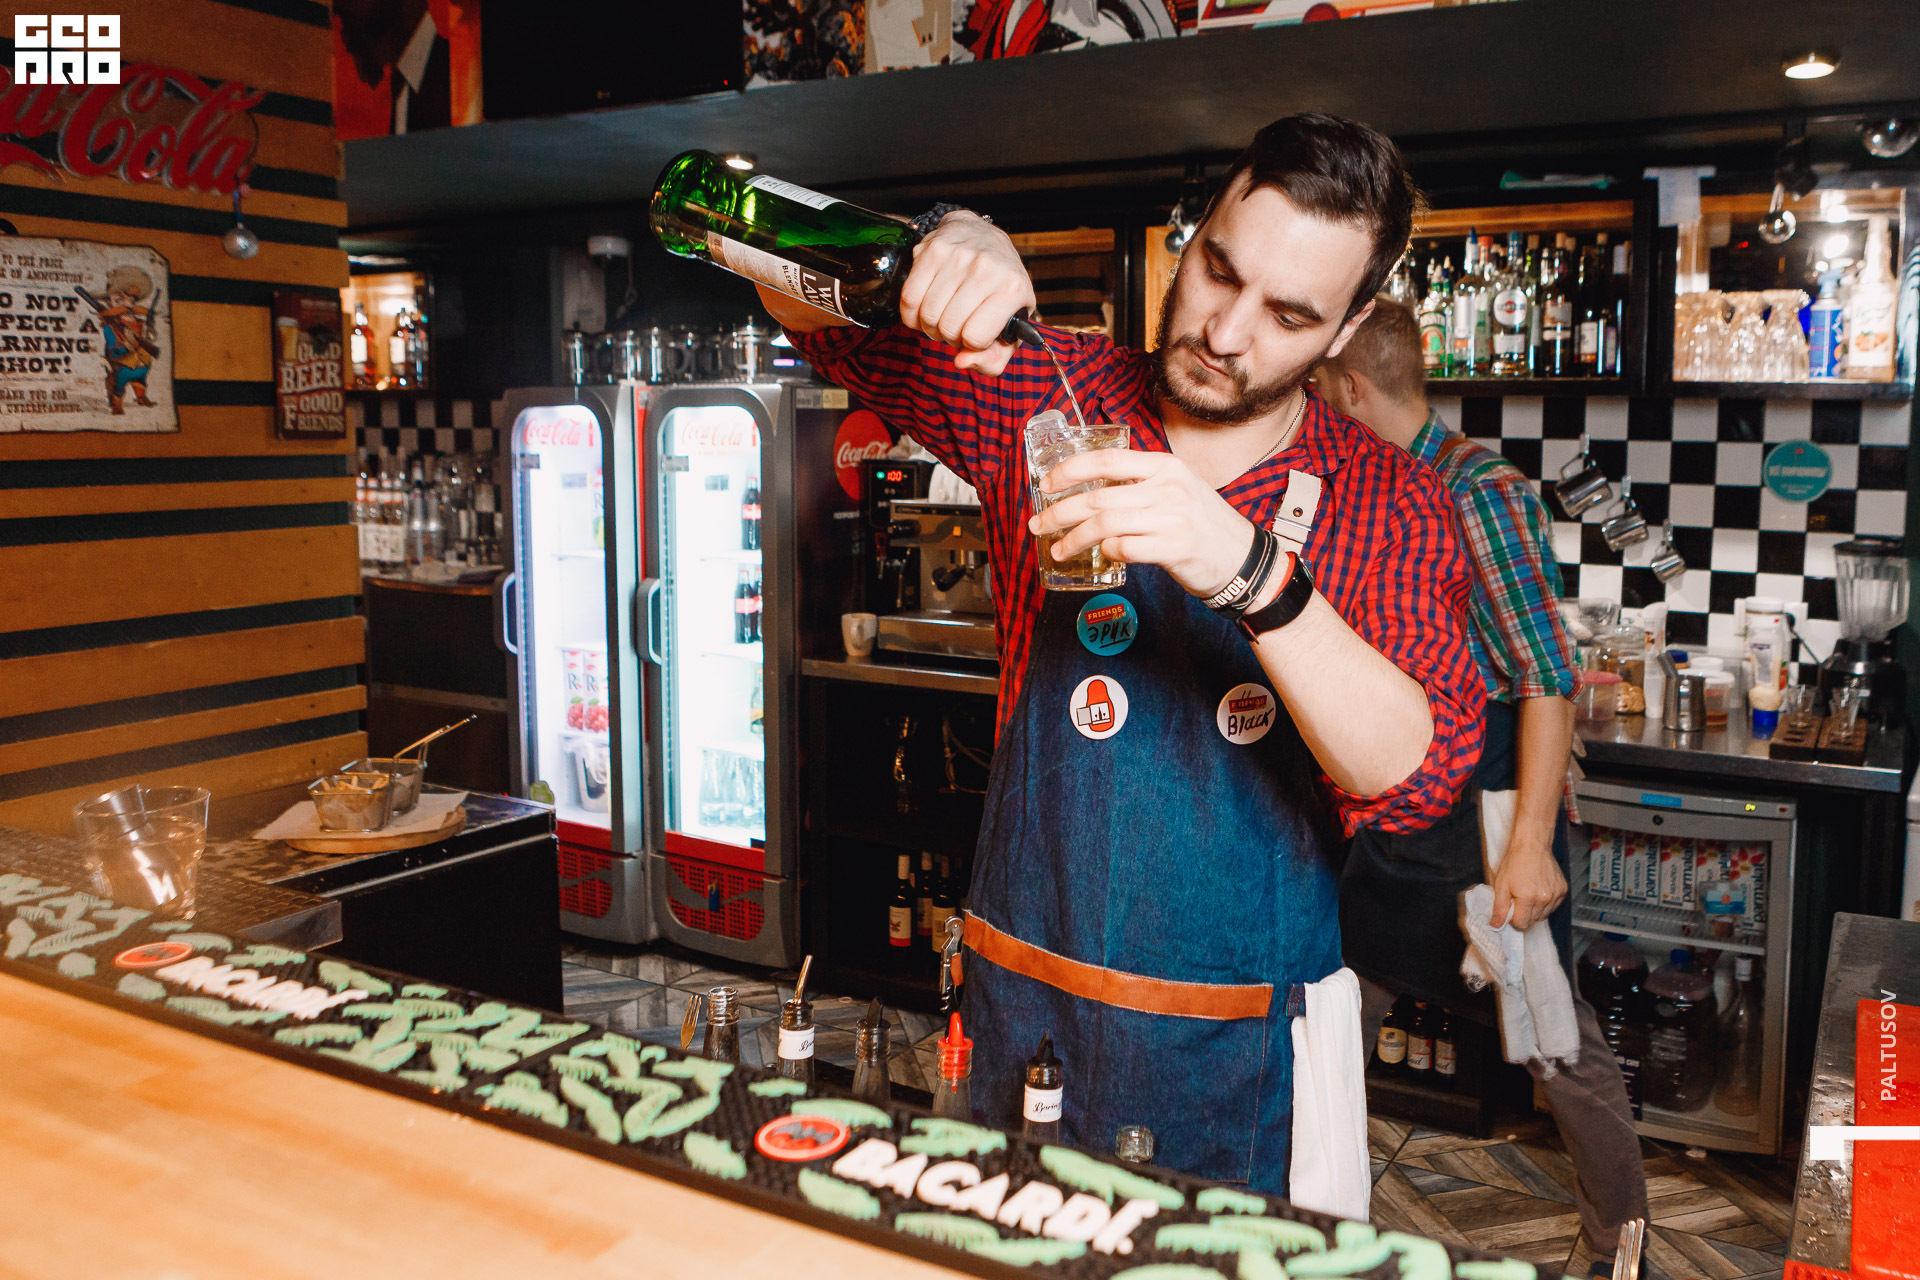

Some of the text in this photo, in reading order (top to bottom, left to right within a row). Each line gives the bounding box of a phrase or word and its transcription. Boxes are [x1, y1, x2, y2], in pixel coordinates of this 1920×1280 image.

[26, 294, 80, 312] NOT
[79, 318, 99, 333] A
[280, 361, 342, 394] BEER
[299, 391, 344, 413] GOOD
[887, 470, 902, 482] 100
[1214, 575, 1247, 606] ROAD
[1088, 606, 1123, 620] FRIENDS
[1228, 707, 1274, 737] Black
